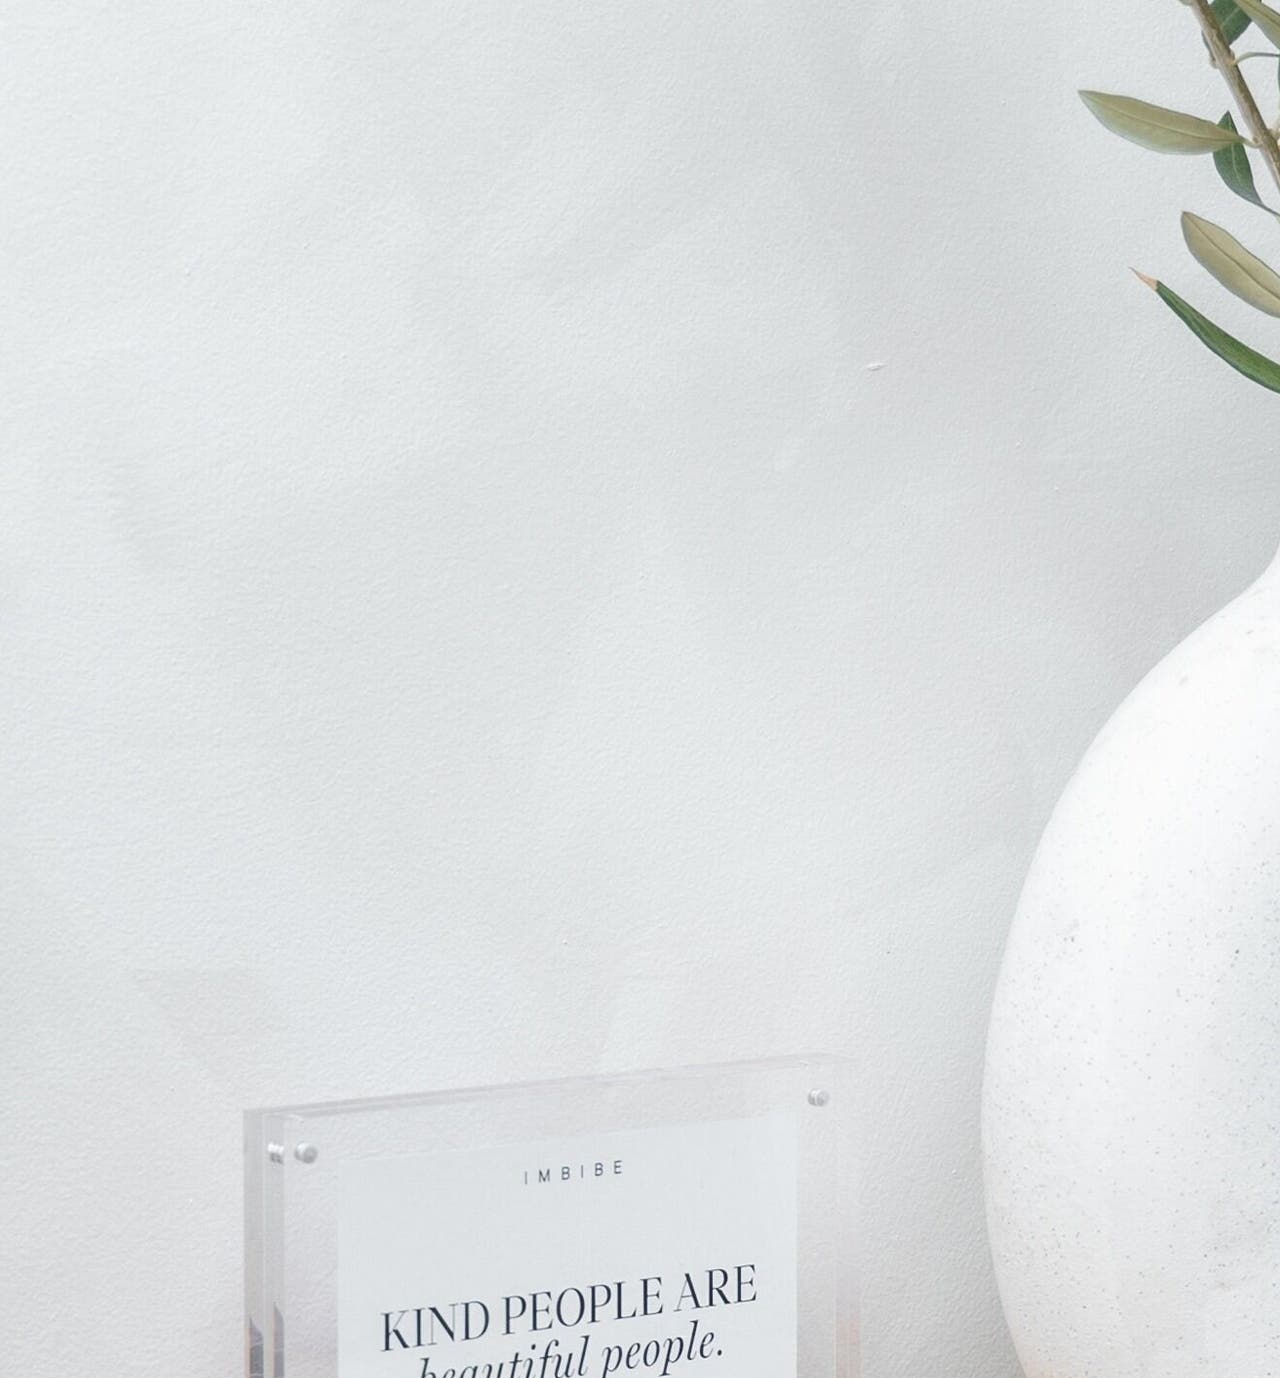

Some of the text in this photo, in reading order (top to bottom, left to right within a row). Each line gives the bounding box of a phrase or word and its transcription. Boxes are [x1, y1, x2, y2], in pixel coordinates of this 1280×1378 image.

[523, 1159, 624, 1186] IMBIBE
[380, 1263, 758, 1352] KIND PEOPLE ARE
